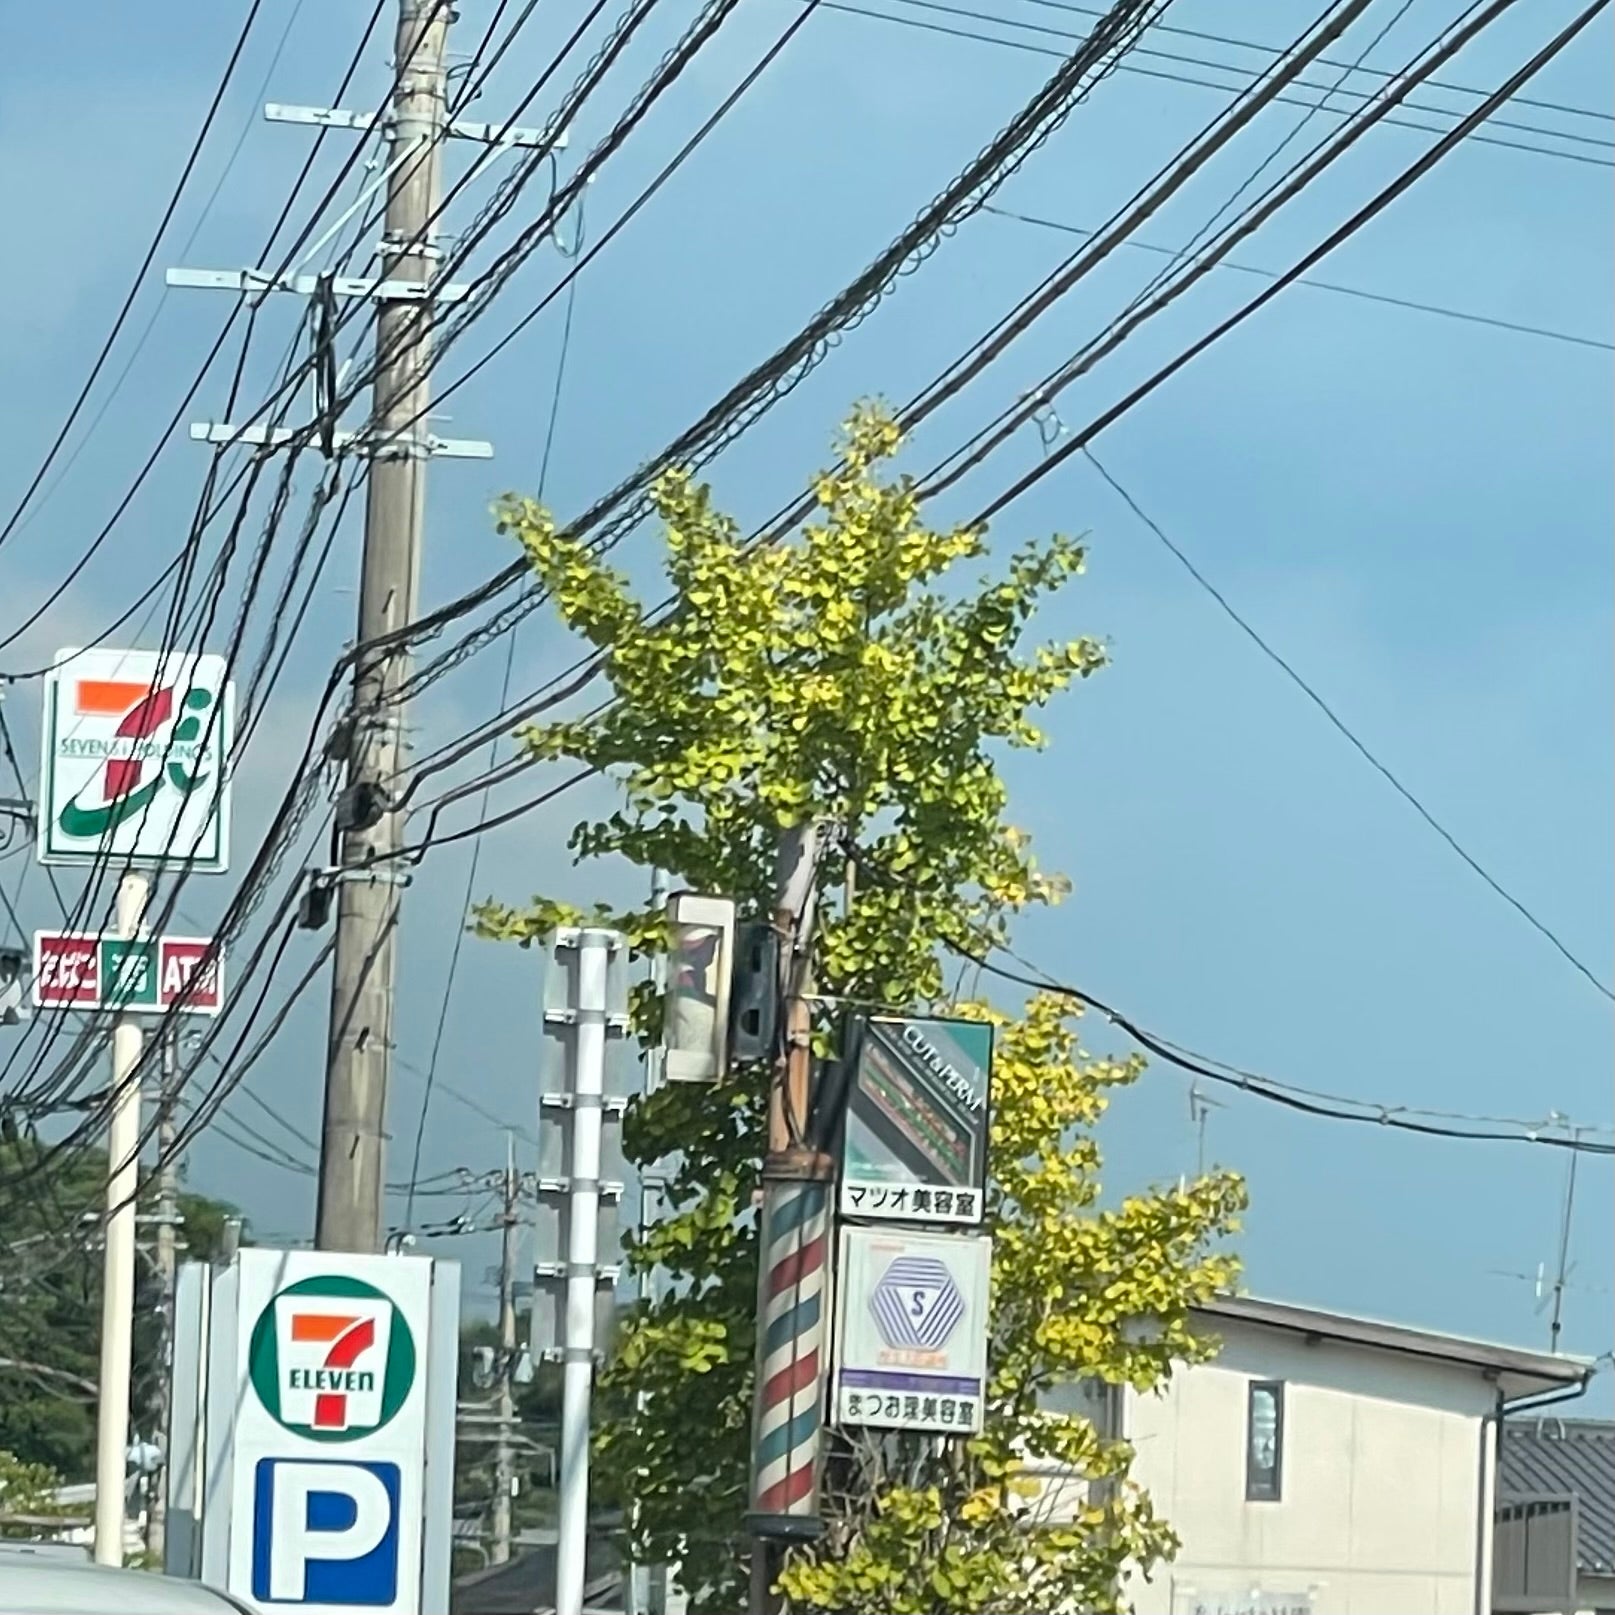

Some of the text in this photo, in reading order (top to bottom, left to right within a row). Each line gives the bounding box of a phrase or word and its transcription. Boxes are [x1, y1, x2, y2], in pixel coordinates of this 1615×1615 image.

[847, 1186, 976, 1217] マツオ美容室
[291, 1314, 375, 1428] 7
[270, 1462, 391, 1601] P
